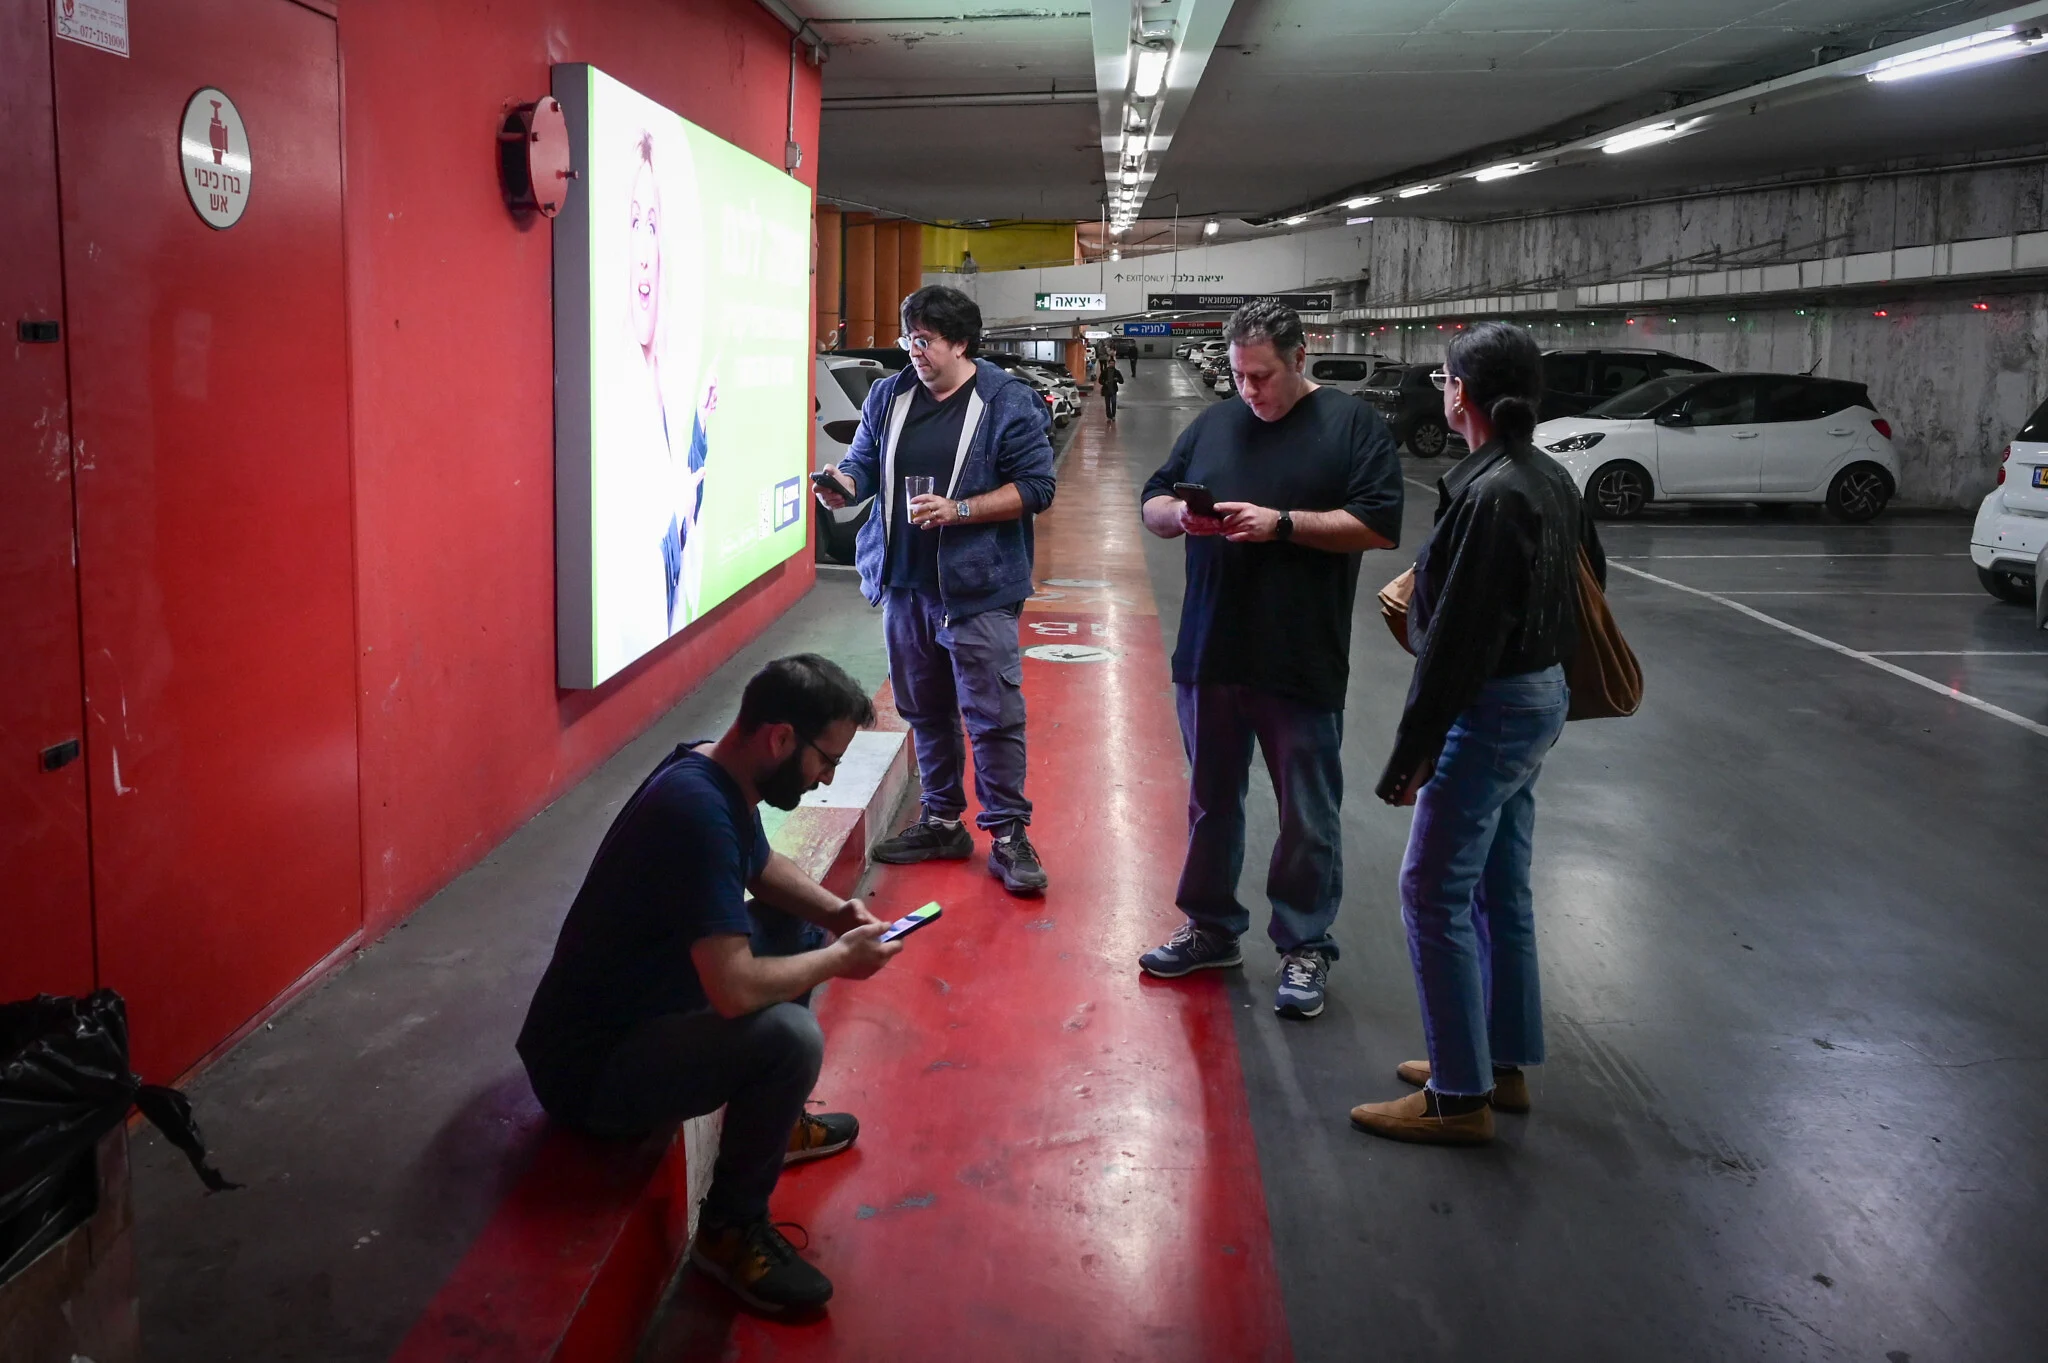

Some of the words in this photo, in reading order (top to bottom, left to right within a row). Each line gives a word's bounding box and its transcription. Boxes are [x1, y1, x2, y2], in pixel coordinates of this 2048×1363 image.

[194, 167, 219, 189] כיבוי
[222, 174, 241, 194] ברז
[209, 193, 229, 213] אש
[1126, 274, 1143, 282] EXIT
[1144, 274, 1164, 283] ONLY
[1197, 274, 1224, 282] יציאה
[1055, 296, 1091, 308] יציאה
[1141, 323, 1166, 333] לחניה
